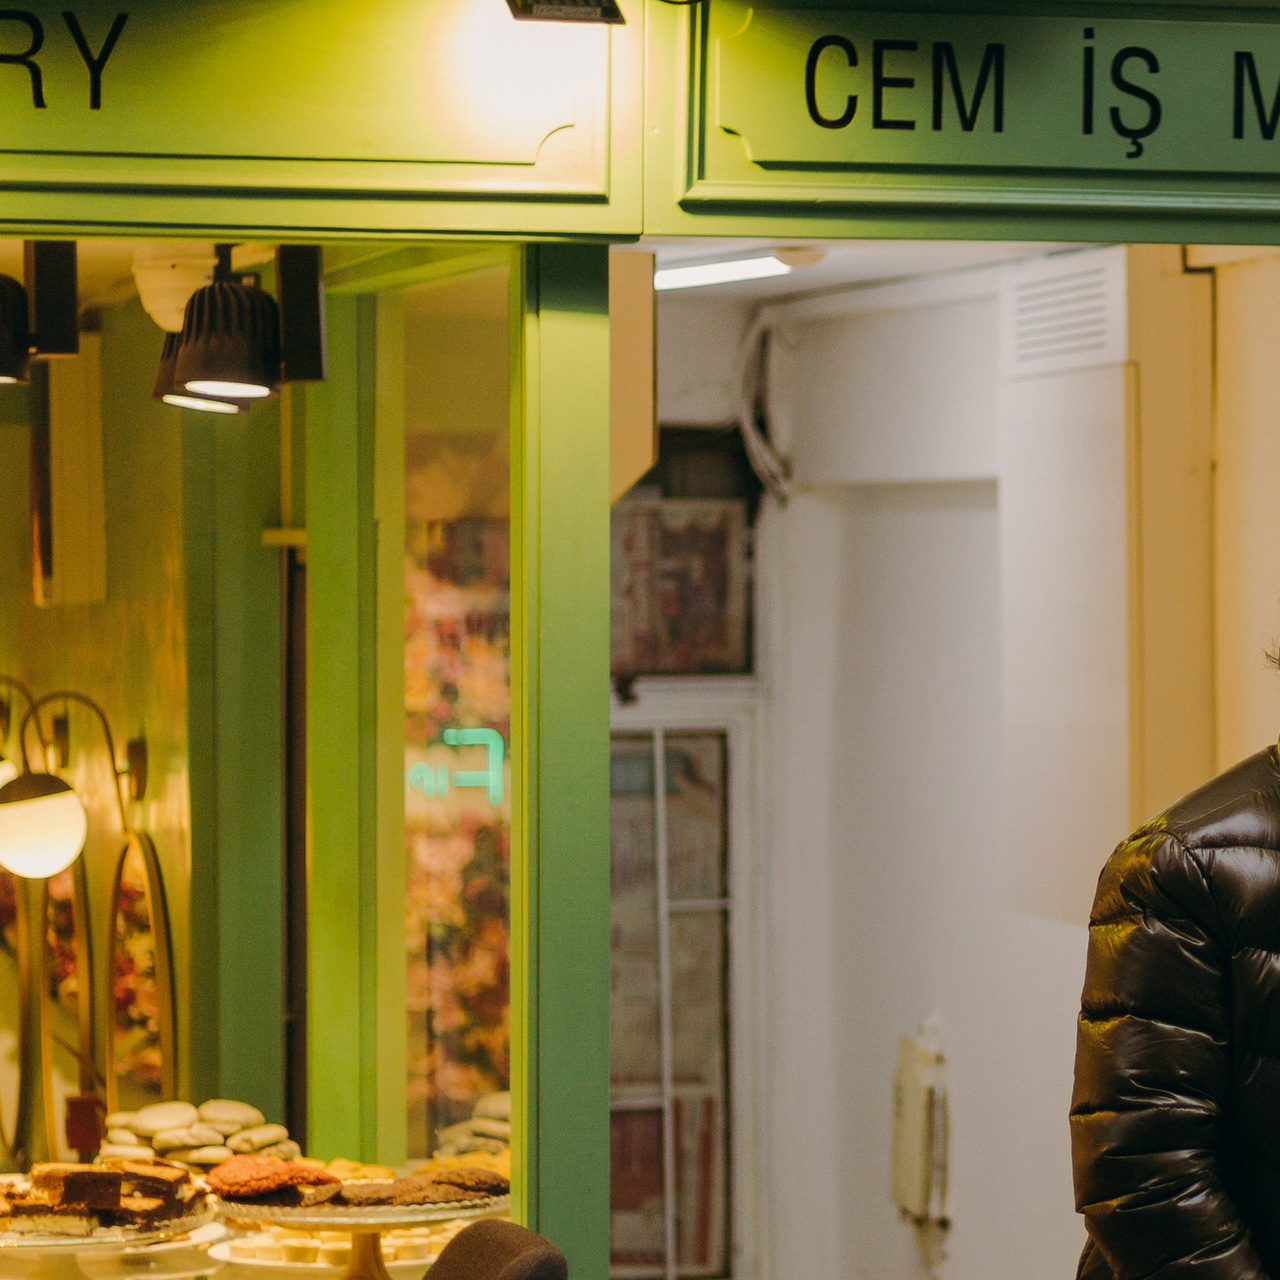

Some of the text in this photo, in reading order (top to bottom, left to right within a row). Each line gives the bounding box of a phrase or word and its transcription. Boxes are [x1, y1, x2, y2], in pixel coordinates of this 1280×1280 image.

[0, 9, 129, 110] RY
[804, 35, 1006, 133] CEM
[1081, 27, 1161, 158] İŞ
